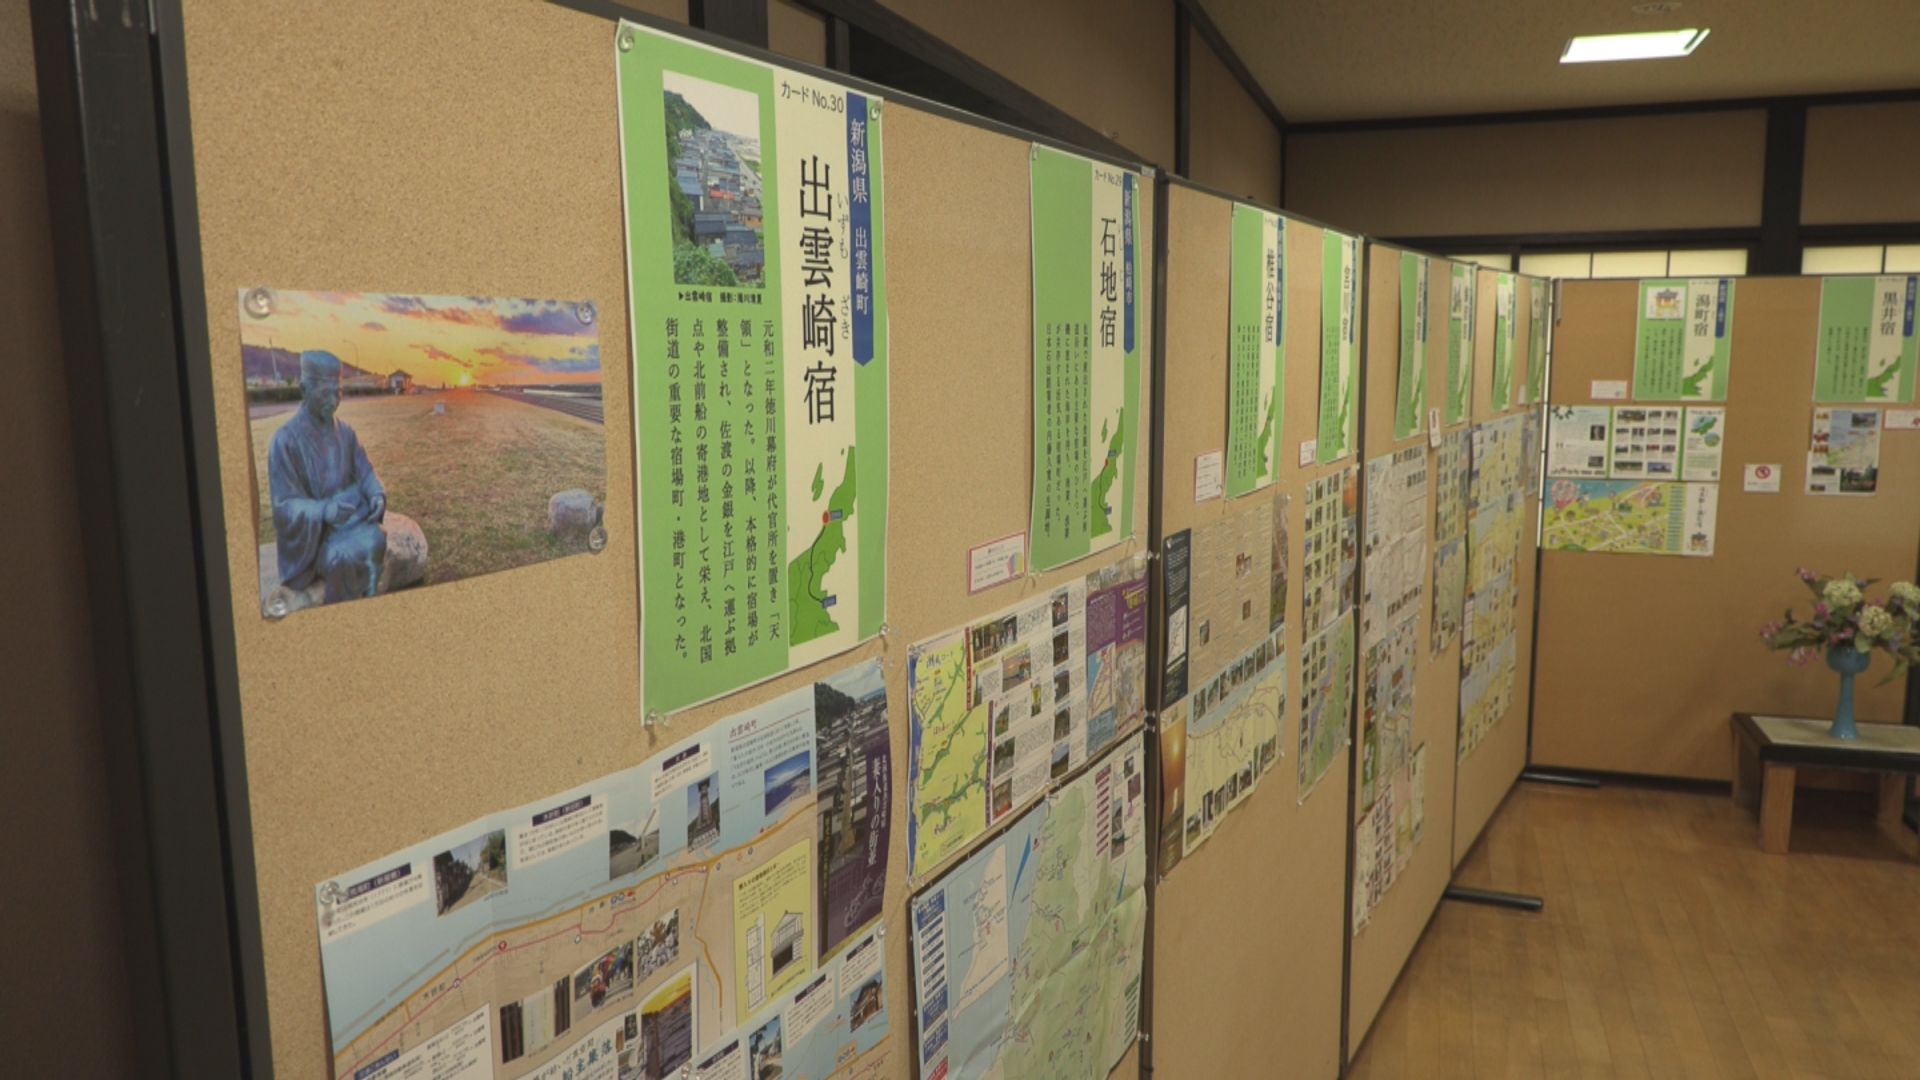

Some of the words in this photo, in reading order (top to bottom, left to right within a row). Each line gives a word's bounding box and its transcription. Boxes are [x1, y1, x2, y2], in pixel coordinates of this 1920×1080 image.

[781, 80, 809, 103] カード
[812, 89, 844, 113] No.30
[850, 118, 867, 203] 新潟県
[799, 154, 838, 426] 出雲崎宿
[855, 226, 869, 316] 出雲崎町
[1100, 217, 1117, 348] 石地宿
